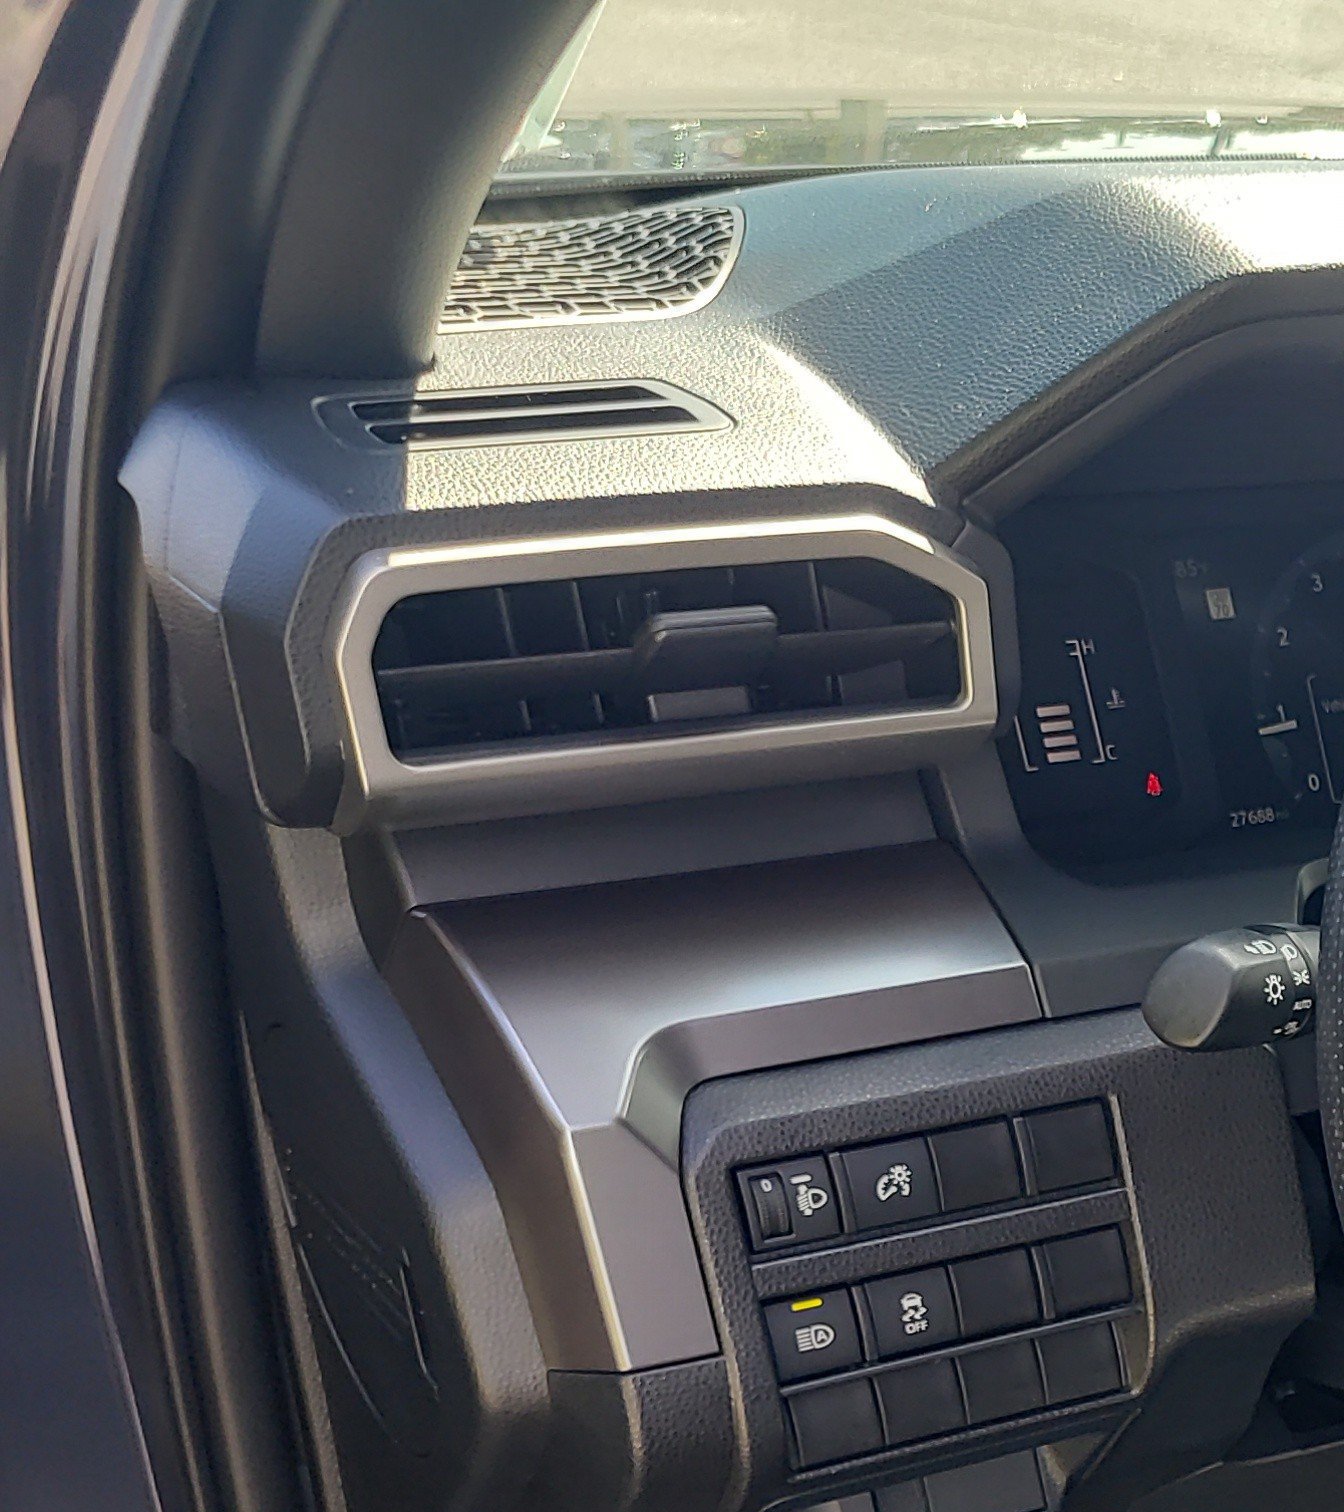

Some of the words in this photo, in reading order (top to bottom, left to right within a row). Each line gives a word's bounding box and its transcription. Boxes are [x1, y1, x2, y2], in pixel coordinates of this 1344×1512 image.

[1311, 573, 1323, 593] 3
[1277, 627, 1290, 647] 2
[1080, 639, 1096, 656] H
[1105, 744, 1118, 761] C
[1308, 773, 1320, 792] 0
[904, 1319, 929, 1335] OFF
